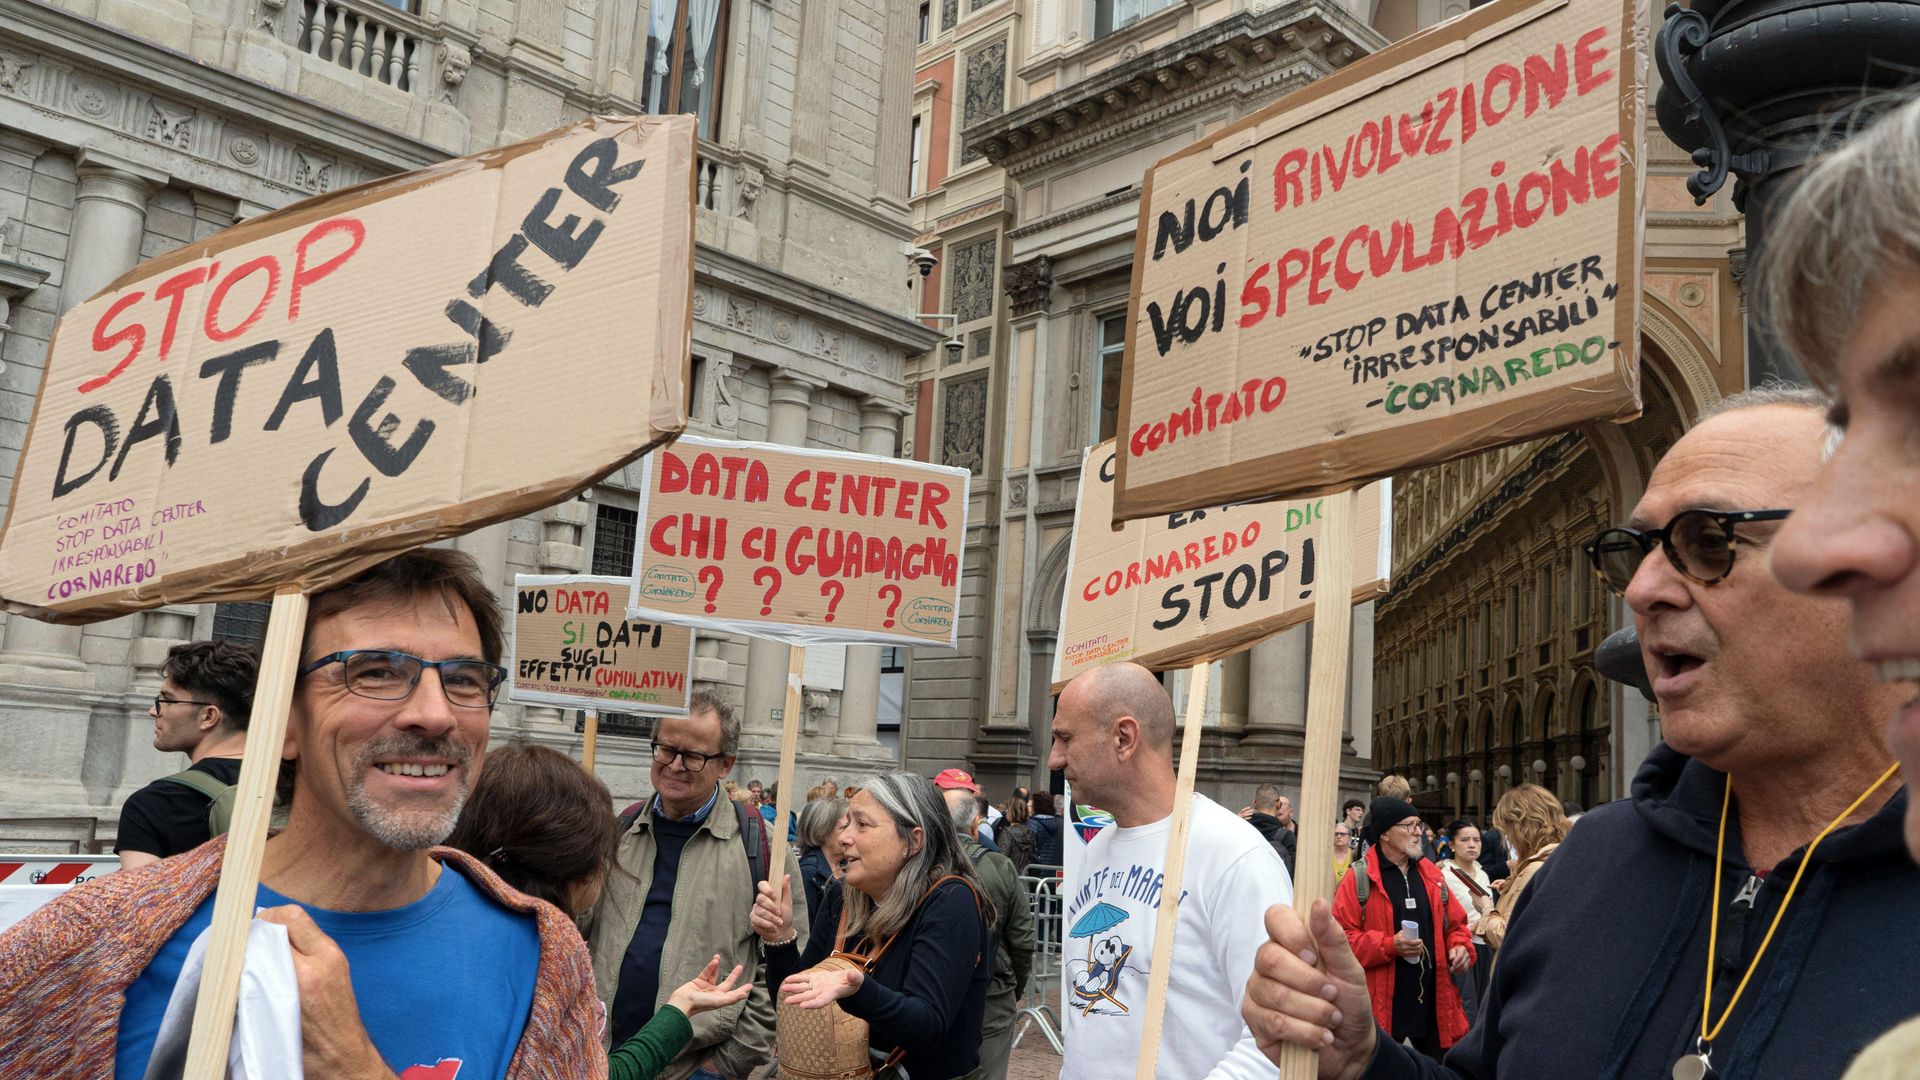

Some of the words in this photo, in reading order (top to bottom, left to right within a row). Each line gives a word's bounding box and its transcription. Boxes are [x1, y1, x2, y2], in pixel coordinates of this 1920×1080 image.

[1273, 26, 1617, 213] RIVOLUZIONE
[77, 217, 367, 394] STOP
[297, 136, 646, 532] CENTER
[1395, 295, 1471, 341] DATA
[1480, 255, 1605, 323] CENTER
[52, 327, 344, 499] DATA
[56, 528, 95, 553] STOP
[103, 516, 141, 541] DATA
[151, 500, 207, 528] CENTER
[659, 450, 769, 504] DATA
[784, 469, 951, 530] CENTER
[649, 511, 729, 562] CHI
[741, 525, 778, 563] CI
[785, 525, 958, 588] GUADAGNA
[1083, 520, 1261, 602] CORNAREDO
[518, 589, 549, 615] NO
[555, 588, 610, 616] DATA
[562, 620, 586, 646] SI
[596, 619, 662, 649] DATI
[698, 564, 725, 615] ?
[753, 565, 783, 617] ?
[820, 579, 845, 624] ?
[878, 583, 902, 629] ?
[519, 658, 592, 684] EFFETTI
[594, 667, 685, 693] CUMULATIVI
[560, 646, 618, 668] SUGLI
[1065, 634, 1108, 656] COMITATO
